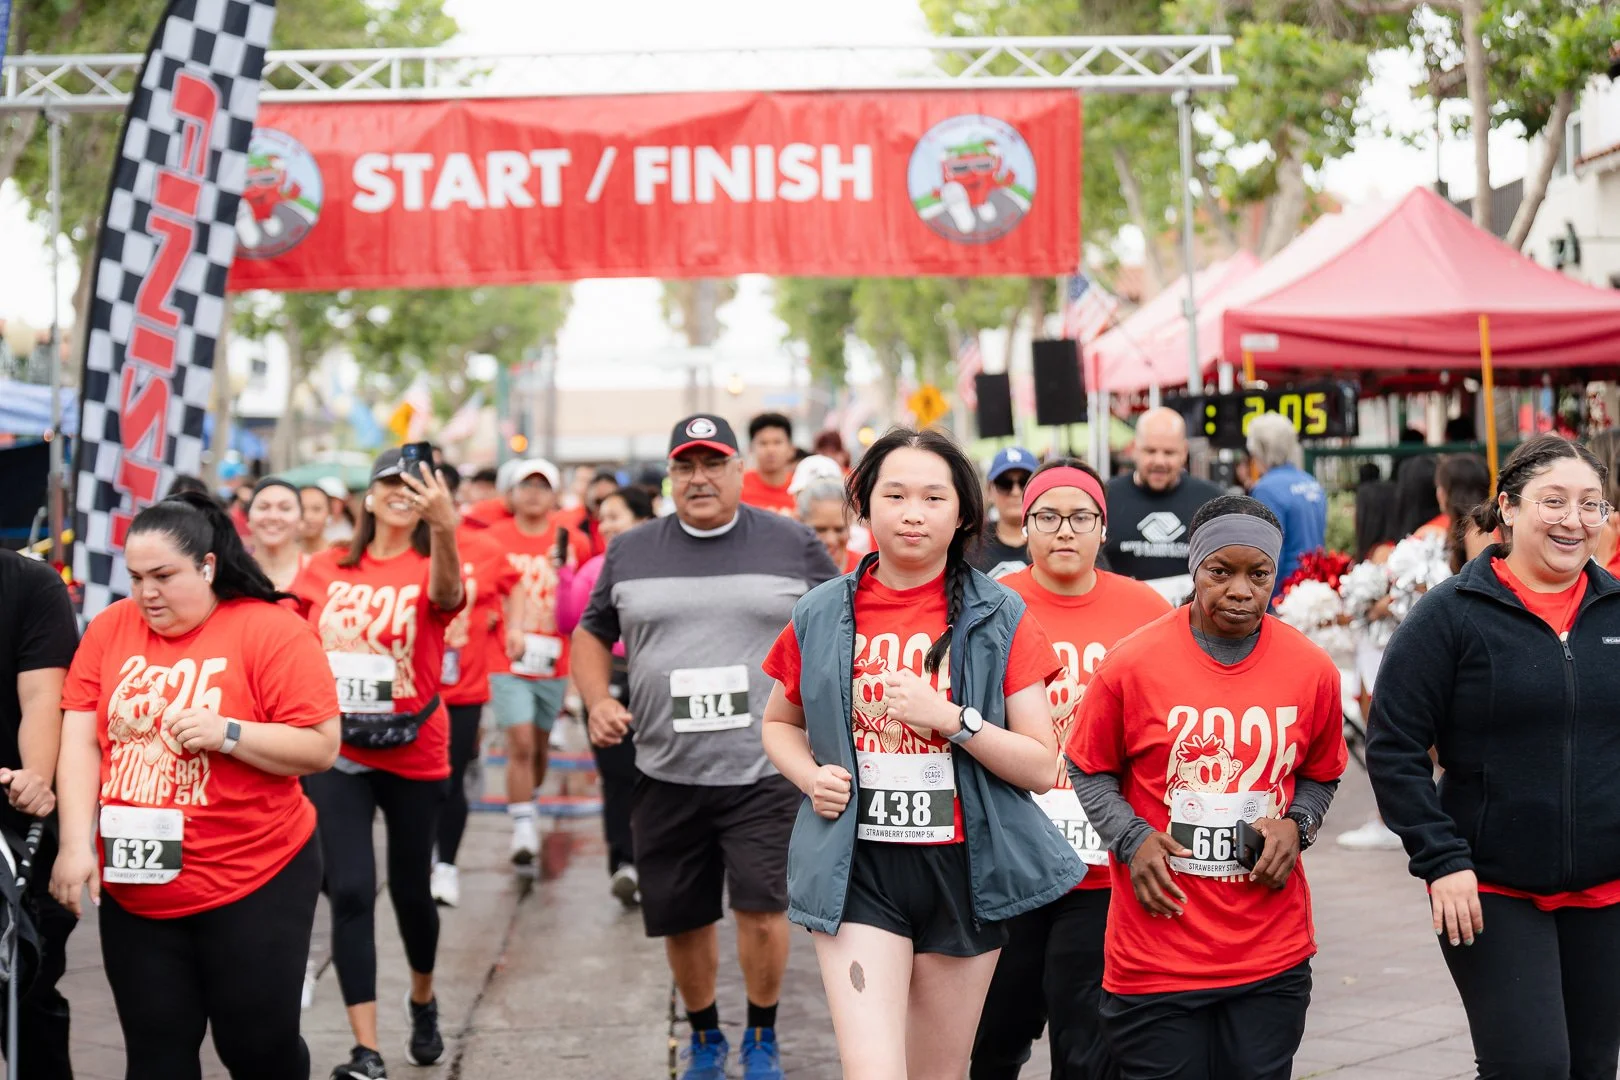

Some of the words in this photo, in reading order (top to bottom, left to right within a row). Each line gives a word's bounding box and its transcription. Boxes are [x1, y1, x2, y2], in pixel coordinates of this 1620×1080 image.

[351, 148, 571, 213] START
[634, 143, 874, 204] FINISH
[109, 70, 220, 549] FINISH
[318, 580, 420, 660] 2025
[107, 655, 227, 755] 2025
[688, 692, 735, 719] 614
[1166, 705, 1298, 815] 2025
[174, 772, 211, 806] 5K
[868, 790, 931, 826] 438
[866, 828, 903, 838] STRAWBERRY
[904, 830, 926, 839] STOMP
[926, 831, 935, 839] 5K
[1193, 827, 1237, 861] 66
[112, 838, 164, 869] 632
[1188, 862, 1226, 872] STRAWBERRY
[1226, 863, 1241, 872] STOM
